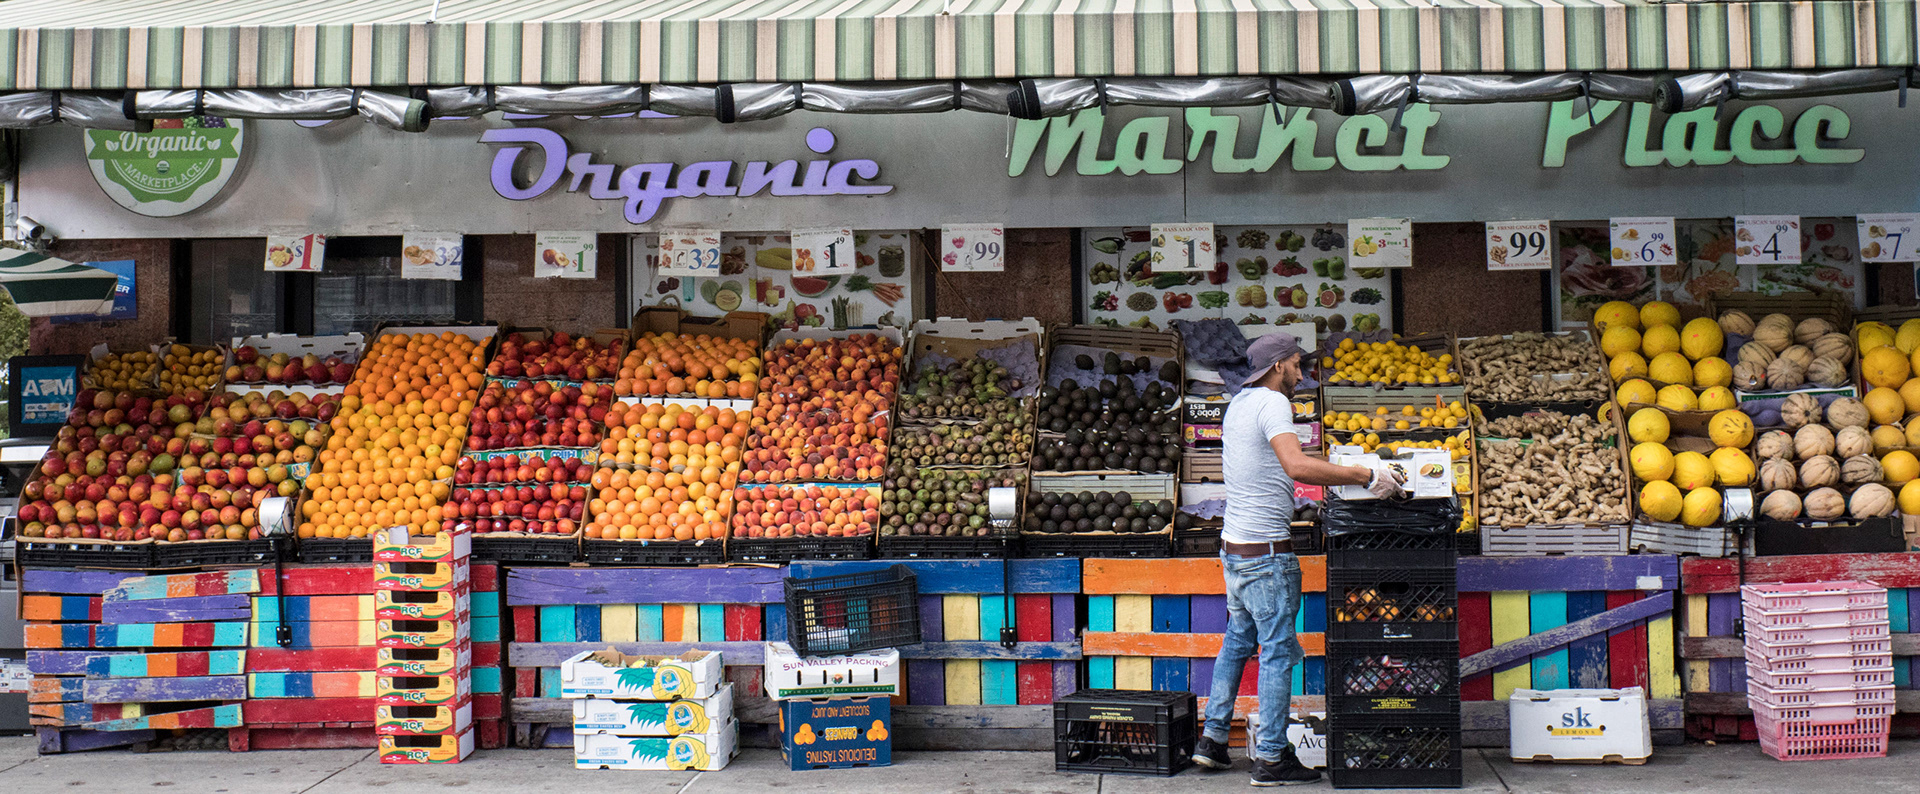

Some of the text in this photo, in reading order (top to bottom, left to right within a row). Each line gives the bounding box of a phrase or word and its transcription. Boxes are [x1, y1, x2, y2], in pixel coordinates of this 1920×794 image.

[119, 130, 207, 159] Organic
[1008, 99, 1866, 177] Market Place
[125, 162, 201, 188] MARKETPLACE
[478, 126, 895, 225] Organic
[974, 241, 1001, 261] 99
[1378, 239, 1386, 248] 3
[1509, 231, 1546, 258] 99
[688, 248, 702, 270] 3
[1189, 407, 1221, 419] globe's
[783, 657, 889, 671] SUN VALLEY PACKING
[811, 705, 870, 719] SUCCULENT AND JUICY
[1562, 706, 1593, 727] sk
[825, 726, 858, 741] ORANGES
[806, 748, 877, 764] DELICIOUS TASTING
